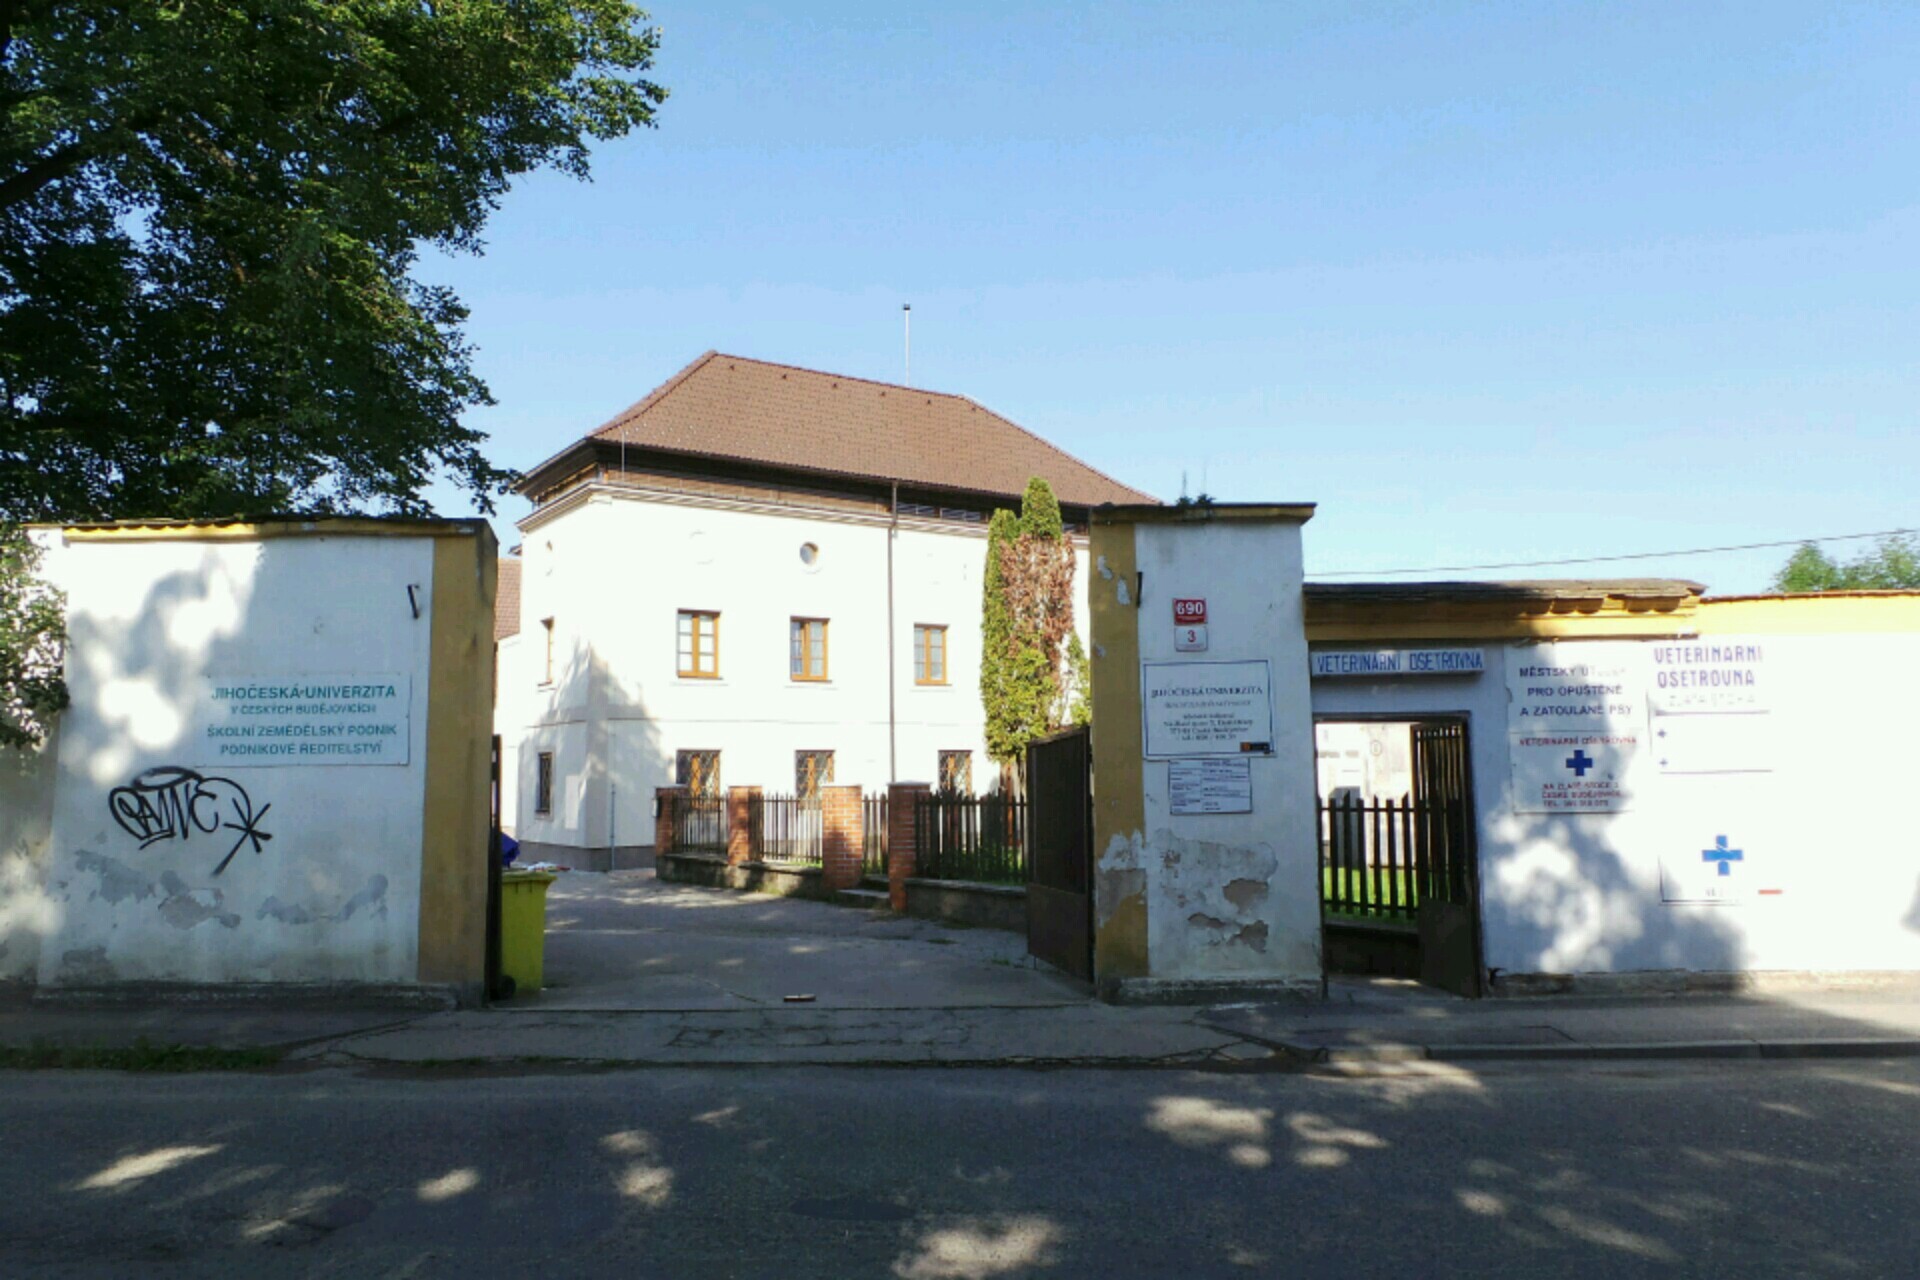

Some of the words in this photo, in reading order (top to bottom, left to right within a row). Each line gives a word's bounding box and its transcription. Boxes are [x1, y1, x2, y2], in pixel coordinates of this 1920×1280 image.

[1176, 601, 1204, 615] 690
[1187, 629, 1197, 643] 3
[211, 683, 300, 700] JIHOČESKÁ
[305, 685, 397, 699] UNIVERZITA
[1527, 687, 1554, 697] PRO
[231, 705, 238, 714] V
[1520, 707, 1529, 716] A
[1609, 705, 1632, 716] PSY
[207, 724, 255, 738] ŠKOLNÍ
[257, 723, 344, 737] ZEMĚDĚLSKÝ
[347, 725, 397, 736] PODNIK
[220, 742, 296, 755] PODNIKOVÉ
[299, 740, 383, 755] ŘEDITELSTVÍ
